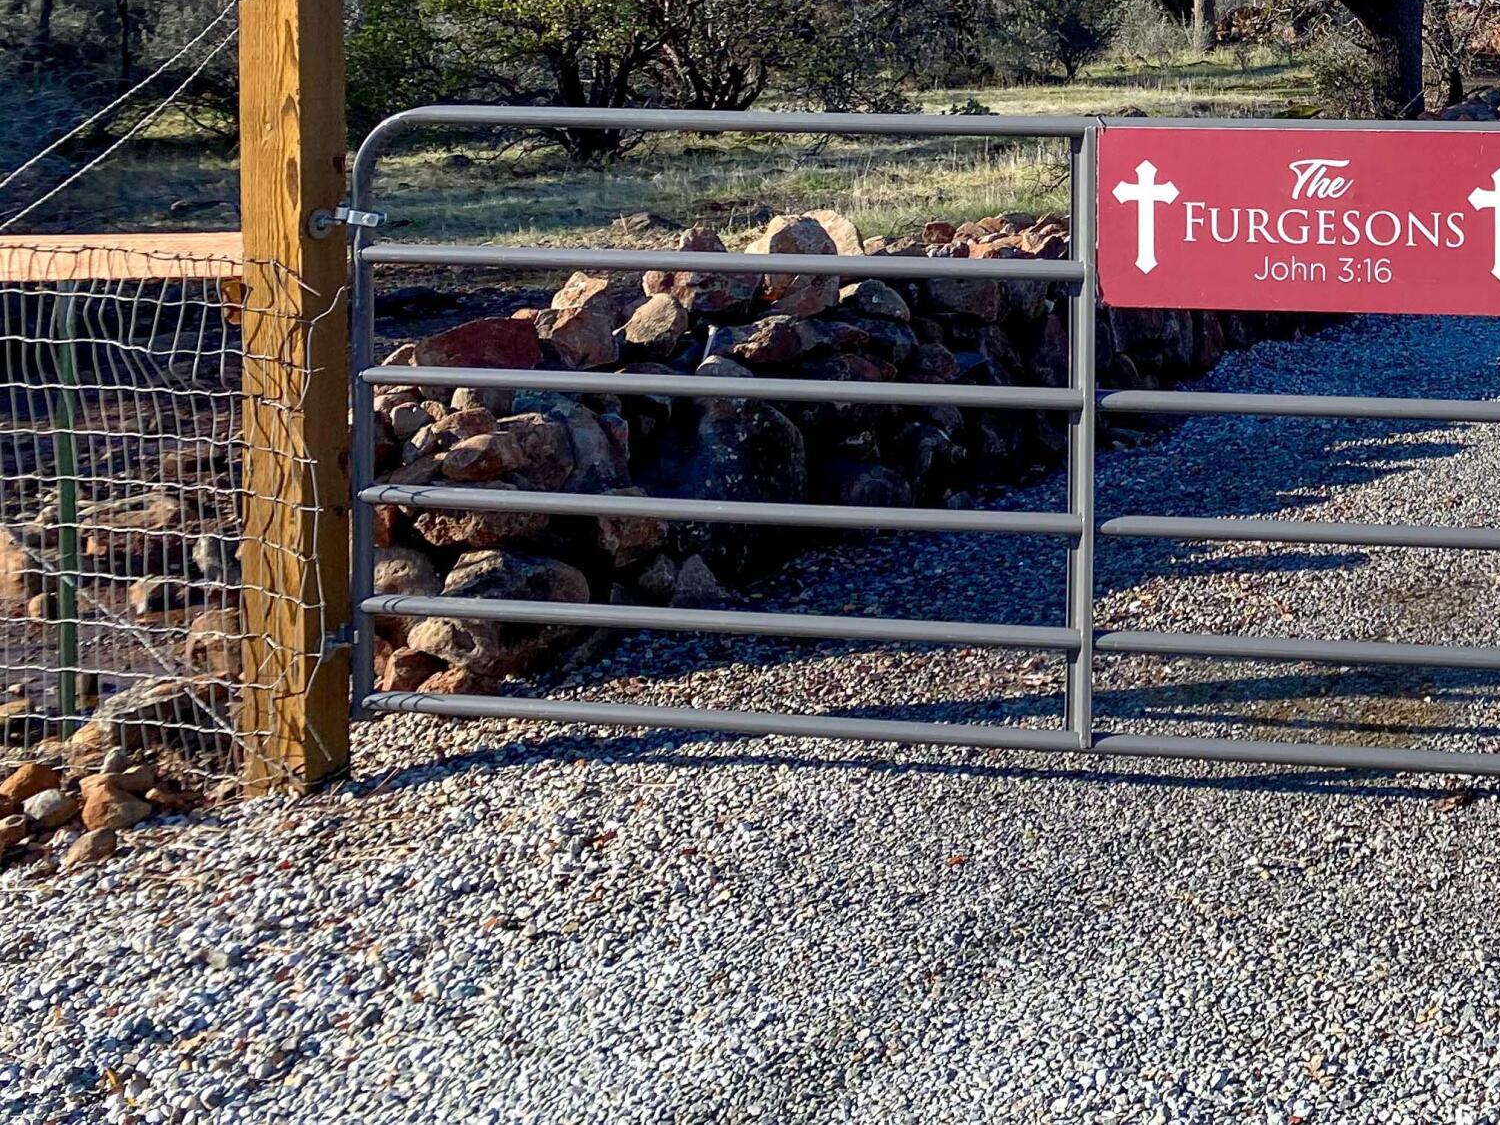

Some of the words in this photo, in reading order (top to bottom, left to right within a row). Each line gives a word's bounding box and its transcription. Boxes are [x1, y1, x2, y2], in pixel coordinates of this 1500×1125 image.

[1288, 159, 1354, 201] The
[1182, 201, 1466, 249] FURGESONS
[1254, 255, 1327, 283] John
[1337, 257, 1393, 284] 3:16
